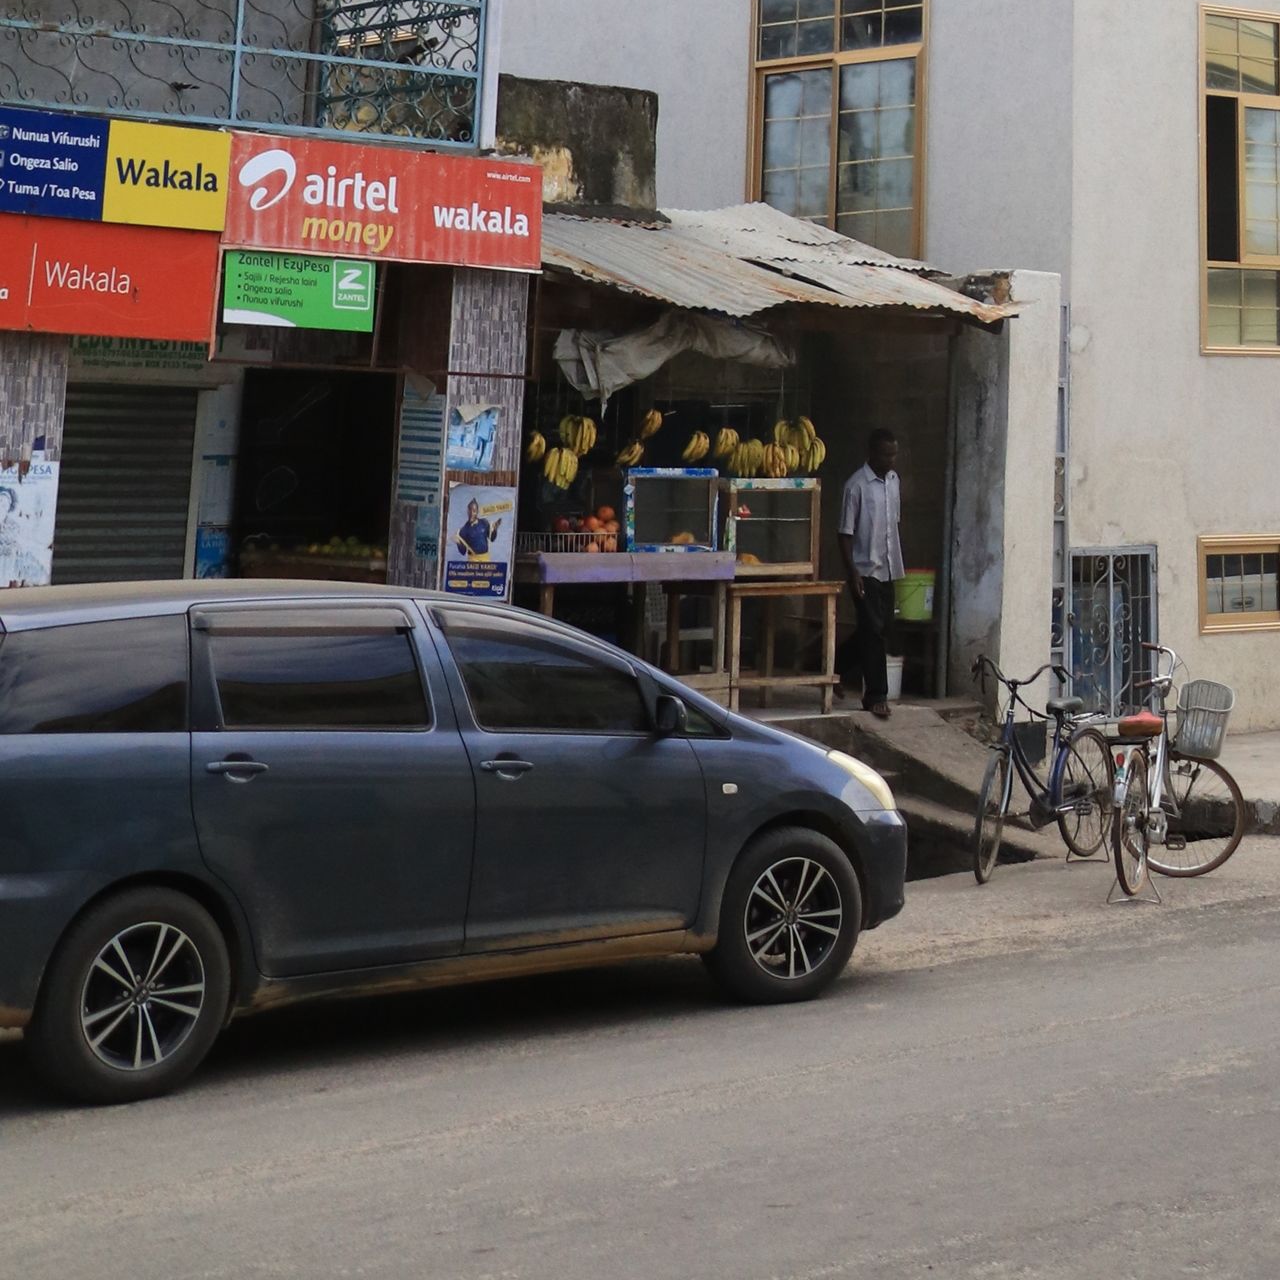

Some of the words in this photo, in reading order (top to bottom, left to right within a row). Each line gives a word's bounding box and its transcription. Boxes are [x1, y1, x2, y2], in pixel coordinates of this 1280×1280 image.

[12, 127, 49, 143] Nunua
[51, 131, 100, 148] Vifurushi
[9, 153, 51, 172] Ongeza
[53, 157, 78, 172] Salio
[116, 157, 218, 193] Wakala
[486, 171, 531, 183] www.airtel.com
[8, 180, 39, 195] Tuma
[50, 184, 70, 199] Toa
[72, 188, 96, 201] Pesa
[303, 165, 399, 214] airtel
[433, 202, 529, 237] wakala
[301, 216, 394, 253] money
[238, 252, 274, 267] Zantel
[283, 257, 330, 273] EzyPesa
[45, 260, 130, 294] Wakala
[244, 272, 263, 282] Sajili
[269, 274, 300, 286] Rejesha
[243, 283, 274, 296] Ongeza
[274, 286, 293, 296] salio
[337, 293, 366, 303] ZANTEL
[242, 294, 269, 304] Nunua
[270, 297, 304, 308] vifurushi
